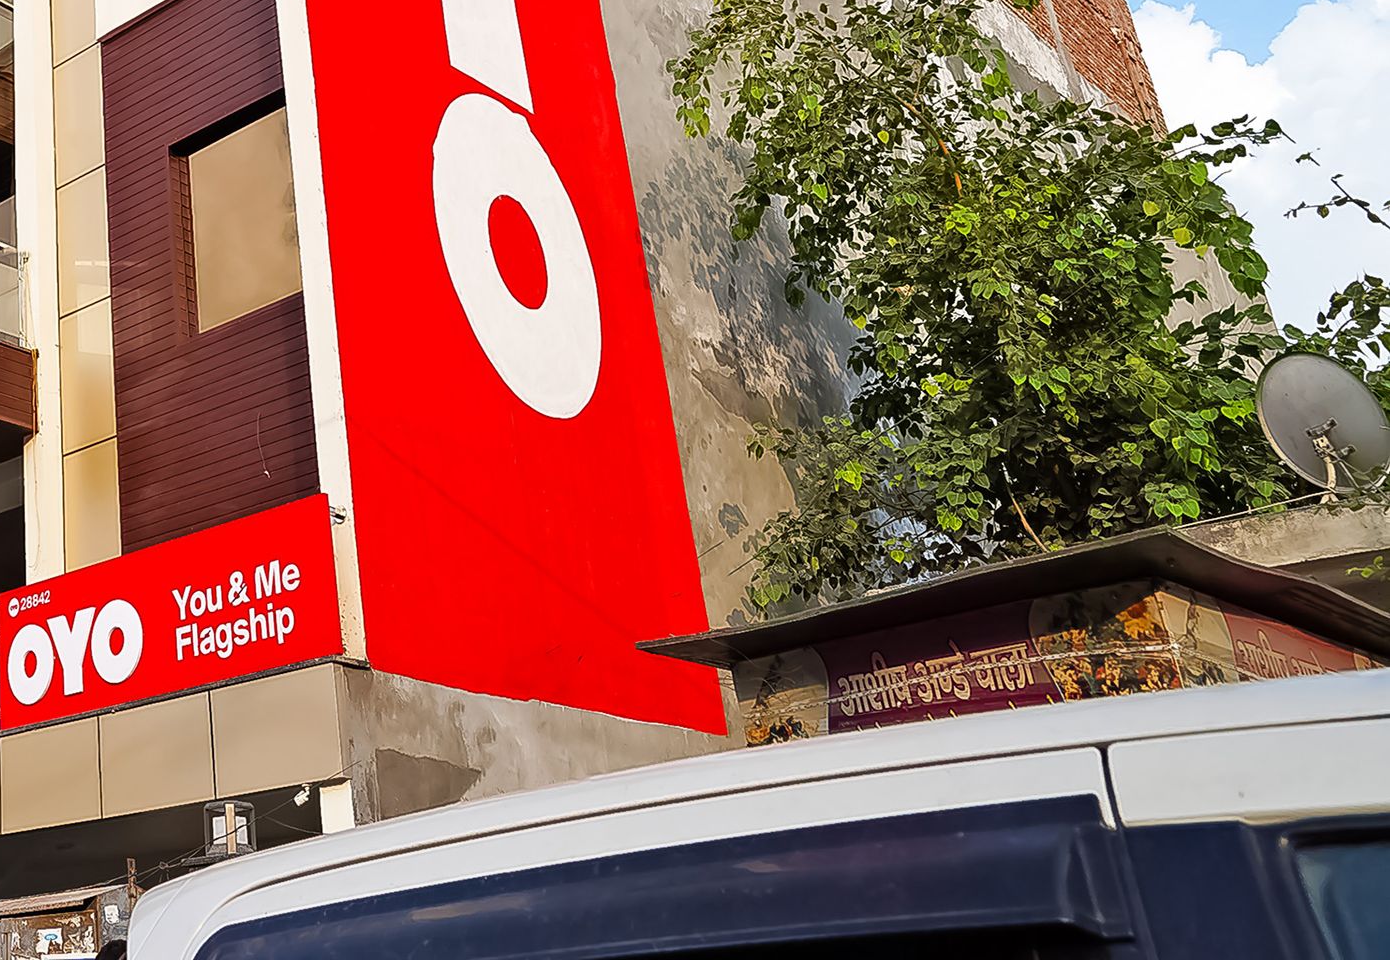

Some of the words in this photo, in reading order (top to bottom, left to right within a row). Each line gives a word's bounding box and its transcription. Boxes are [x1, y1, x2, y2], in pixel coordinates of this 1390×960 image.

[20, 590, 51, 611] 28842
[172, 583, 222, 620] You
[228, 570, 250, 607] &
[254, 559, 301, 599] Me
[7, 599, 144, 705] OYO
[174, 602, 295, 662] Flagship
